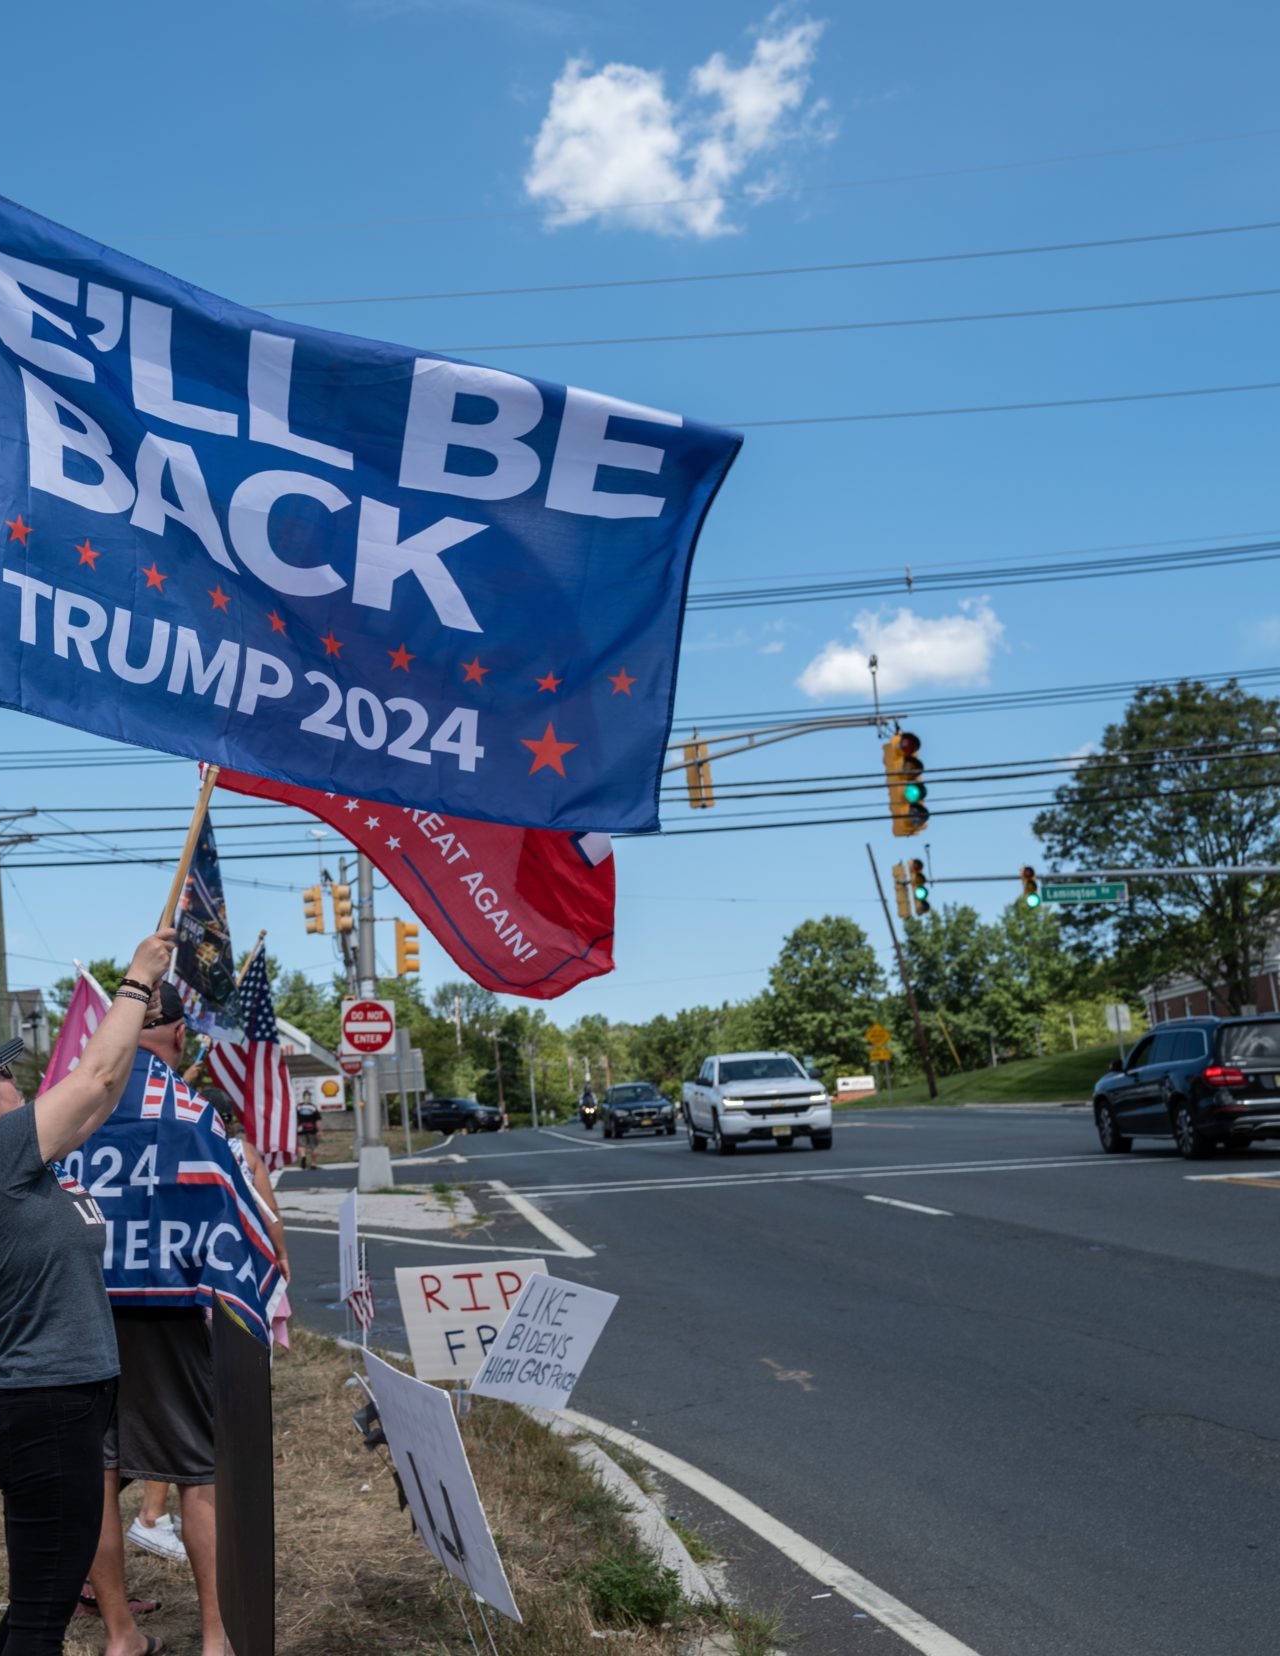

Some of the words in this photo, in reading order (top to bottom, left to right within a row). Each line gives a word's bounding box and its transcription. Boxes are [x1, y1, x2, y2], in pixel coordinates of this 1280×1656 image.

[398, 357, 683, 519] BE
[19, 365, 490, 634] BACK
[2, 568, 294, 717] TRUMP
[299, 669, 485, 773] 2024
[402, 806, 470, 866] REAT
[459, 870, 539, 965] AGAIN!
[1046, 887, 1097, 900] Lamington
[350, 1010, 364, 1021] DO
[366, 1010, 385, 1021] NOT
[353, 1033, 383, 1044] ENTER
[63, 1144, 161, 1198] 024
[103, 1219, 265, 1300] ERICA
[420, 1271, 523, 1314] RIP
[517, 1281, 577, 1327] LIKE
[506, 1323, 574, 1360] BIDEN'S
[480, 1356, 521, 1385] HIGH
[518, 1357, 552, 1386] GAS
